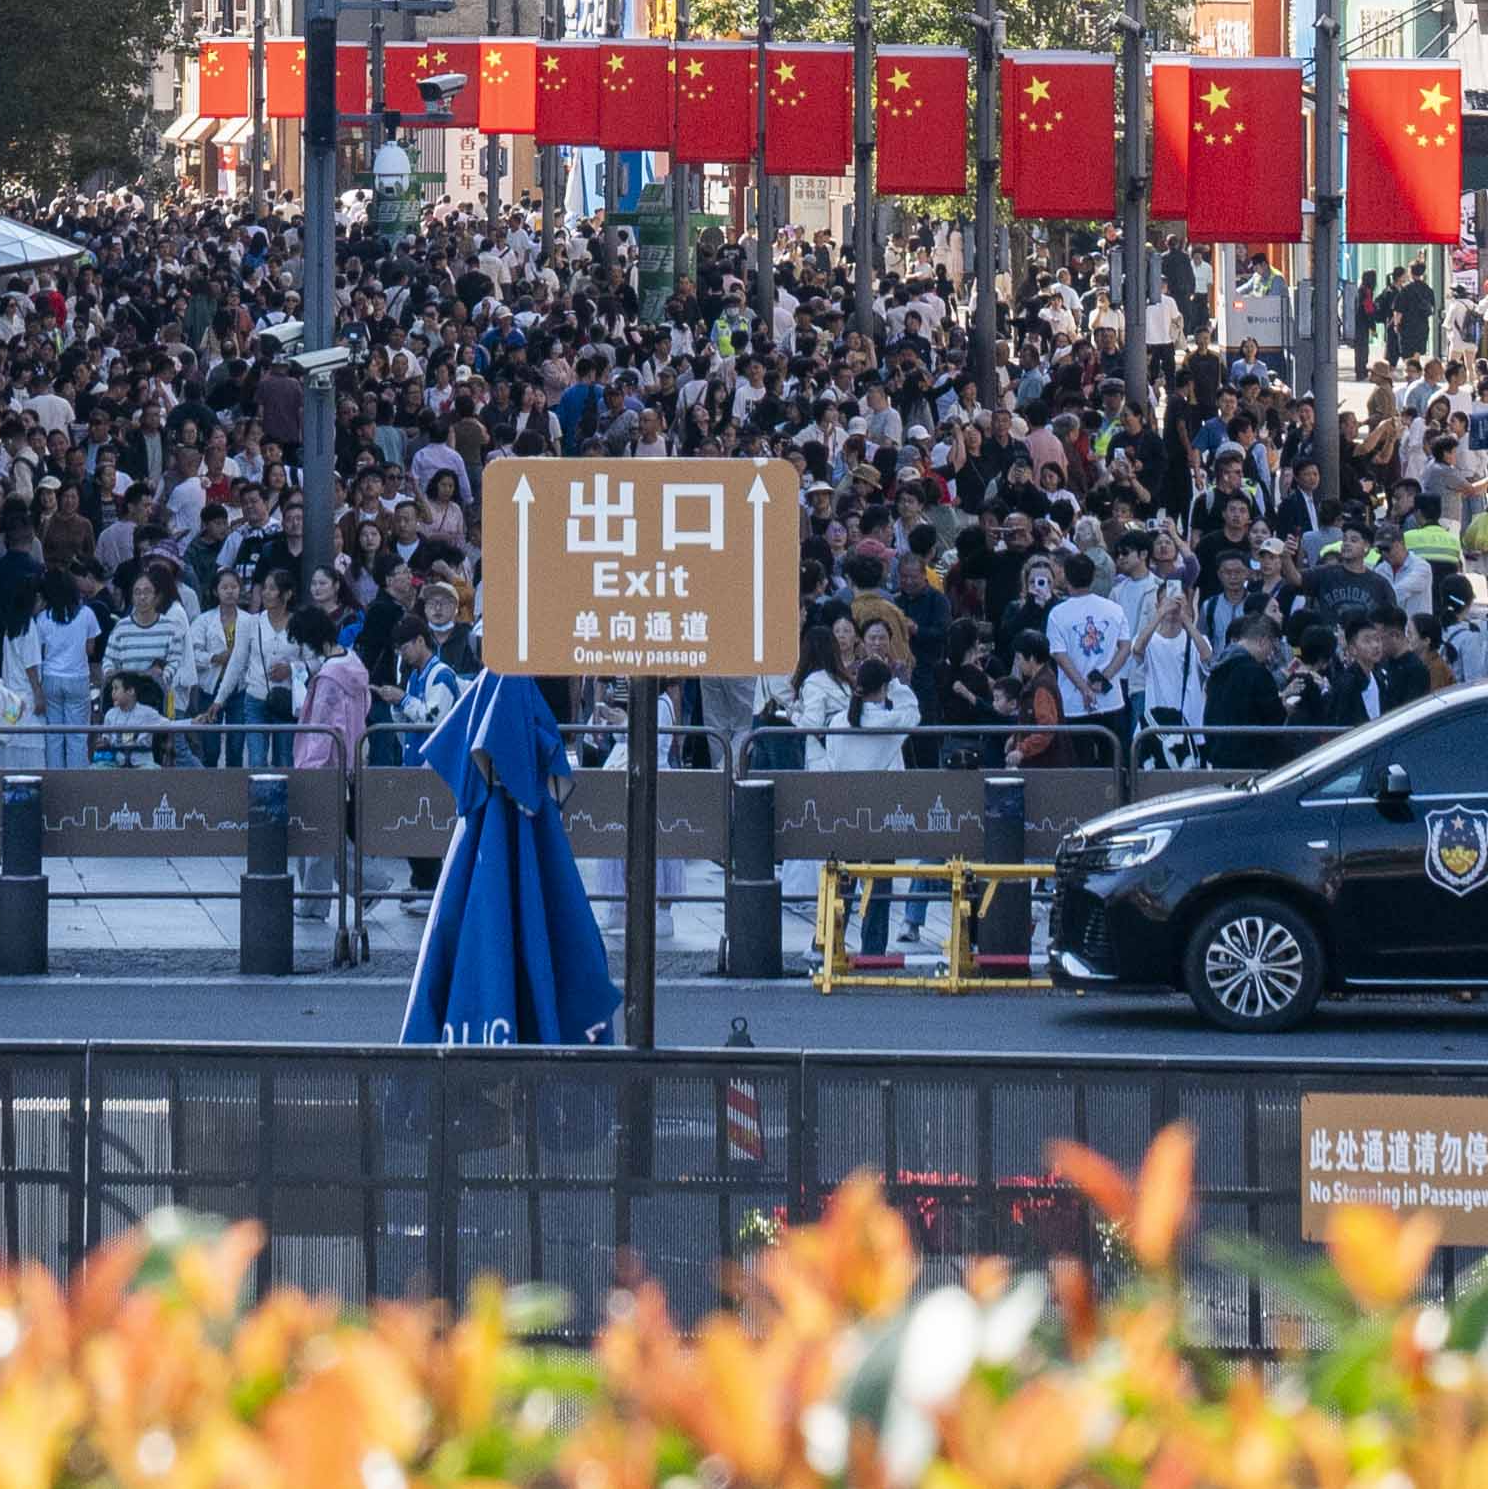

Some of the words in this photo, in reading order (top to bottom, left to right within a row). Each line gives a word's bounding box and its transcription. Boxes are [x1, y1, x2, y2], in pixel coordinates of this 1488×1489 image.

[566, 473, 724, 557] 出口
[593, 561, 689, 598] Exit
[573, 610, 709, 642] 单向通道
[574, 646, 643, 667] One-way
[645, 649, 708, 667] passage
[1310, 1181, 1331, 1203] No
[1403, 1181, 1418, 1205] in
